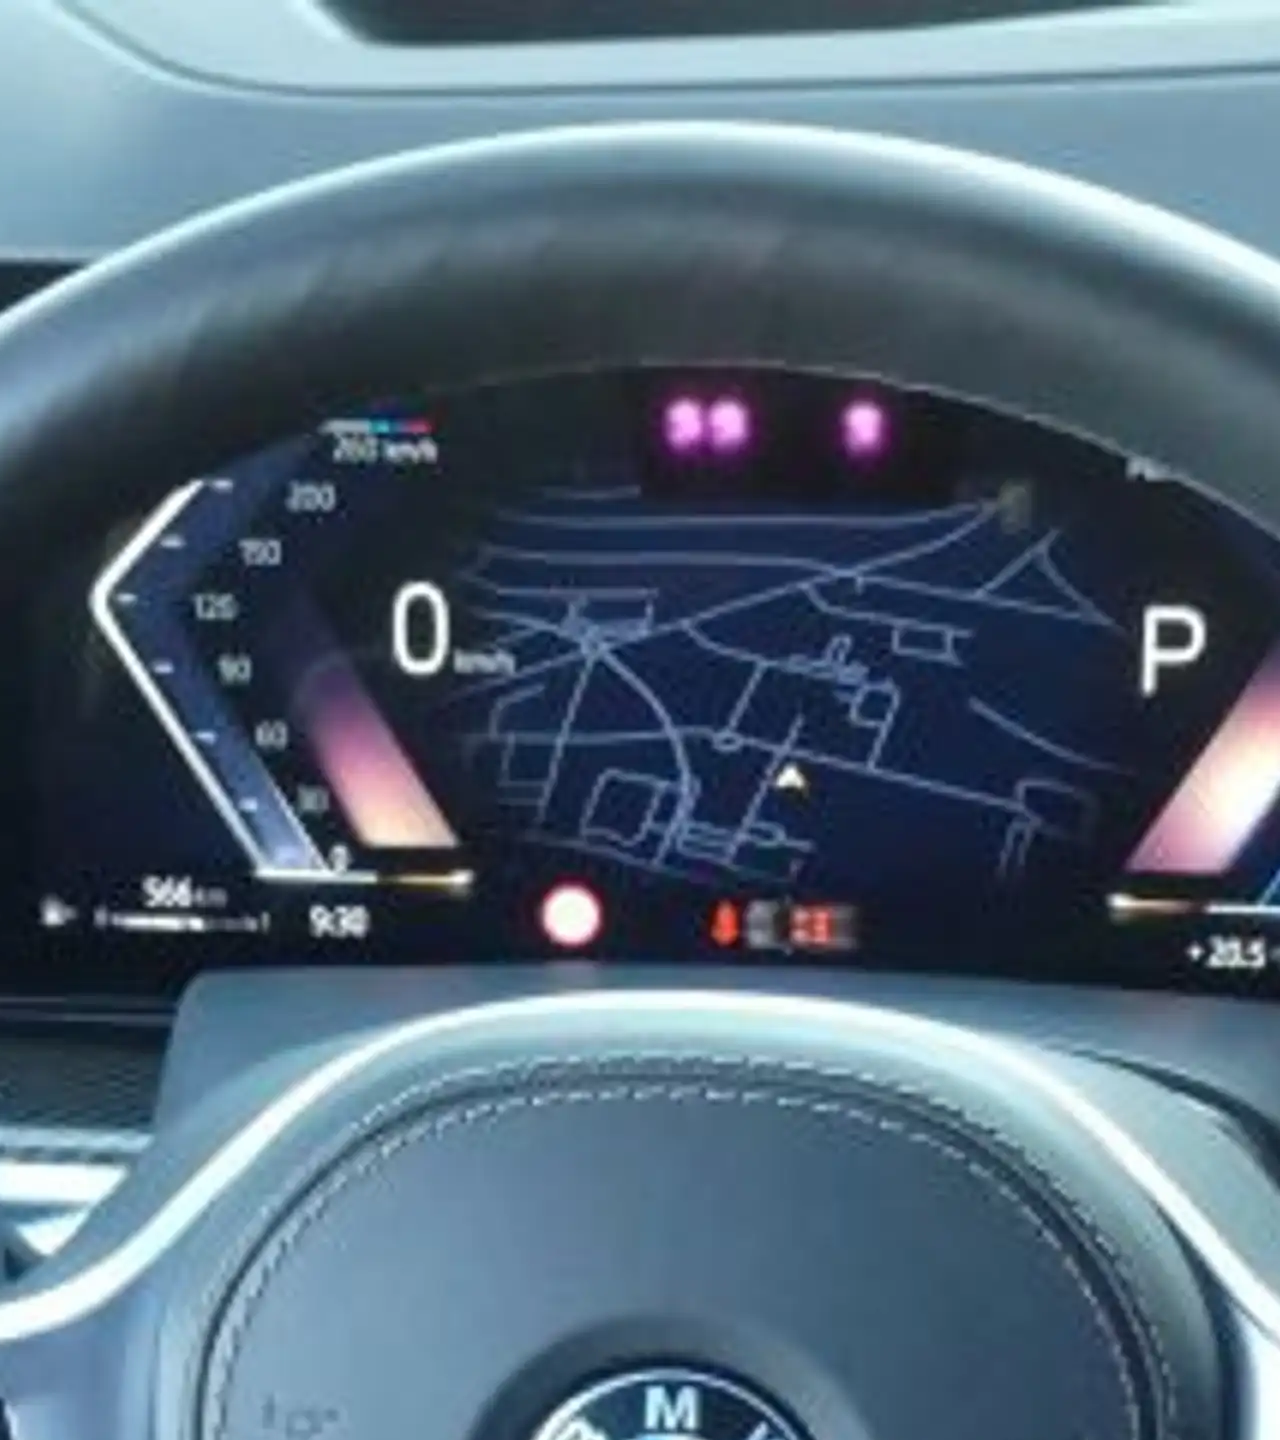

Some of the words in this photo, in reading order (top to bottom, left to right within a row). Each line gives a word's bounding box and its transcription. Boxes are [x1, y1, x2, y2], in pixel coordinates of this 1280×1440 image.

[285, 482, 336, 512] 200
[238, 538, 282, 566] 150
[393, 581, 450, 676] 0
[1139, 603, 1206, 696] P
